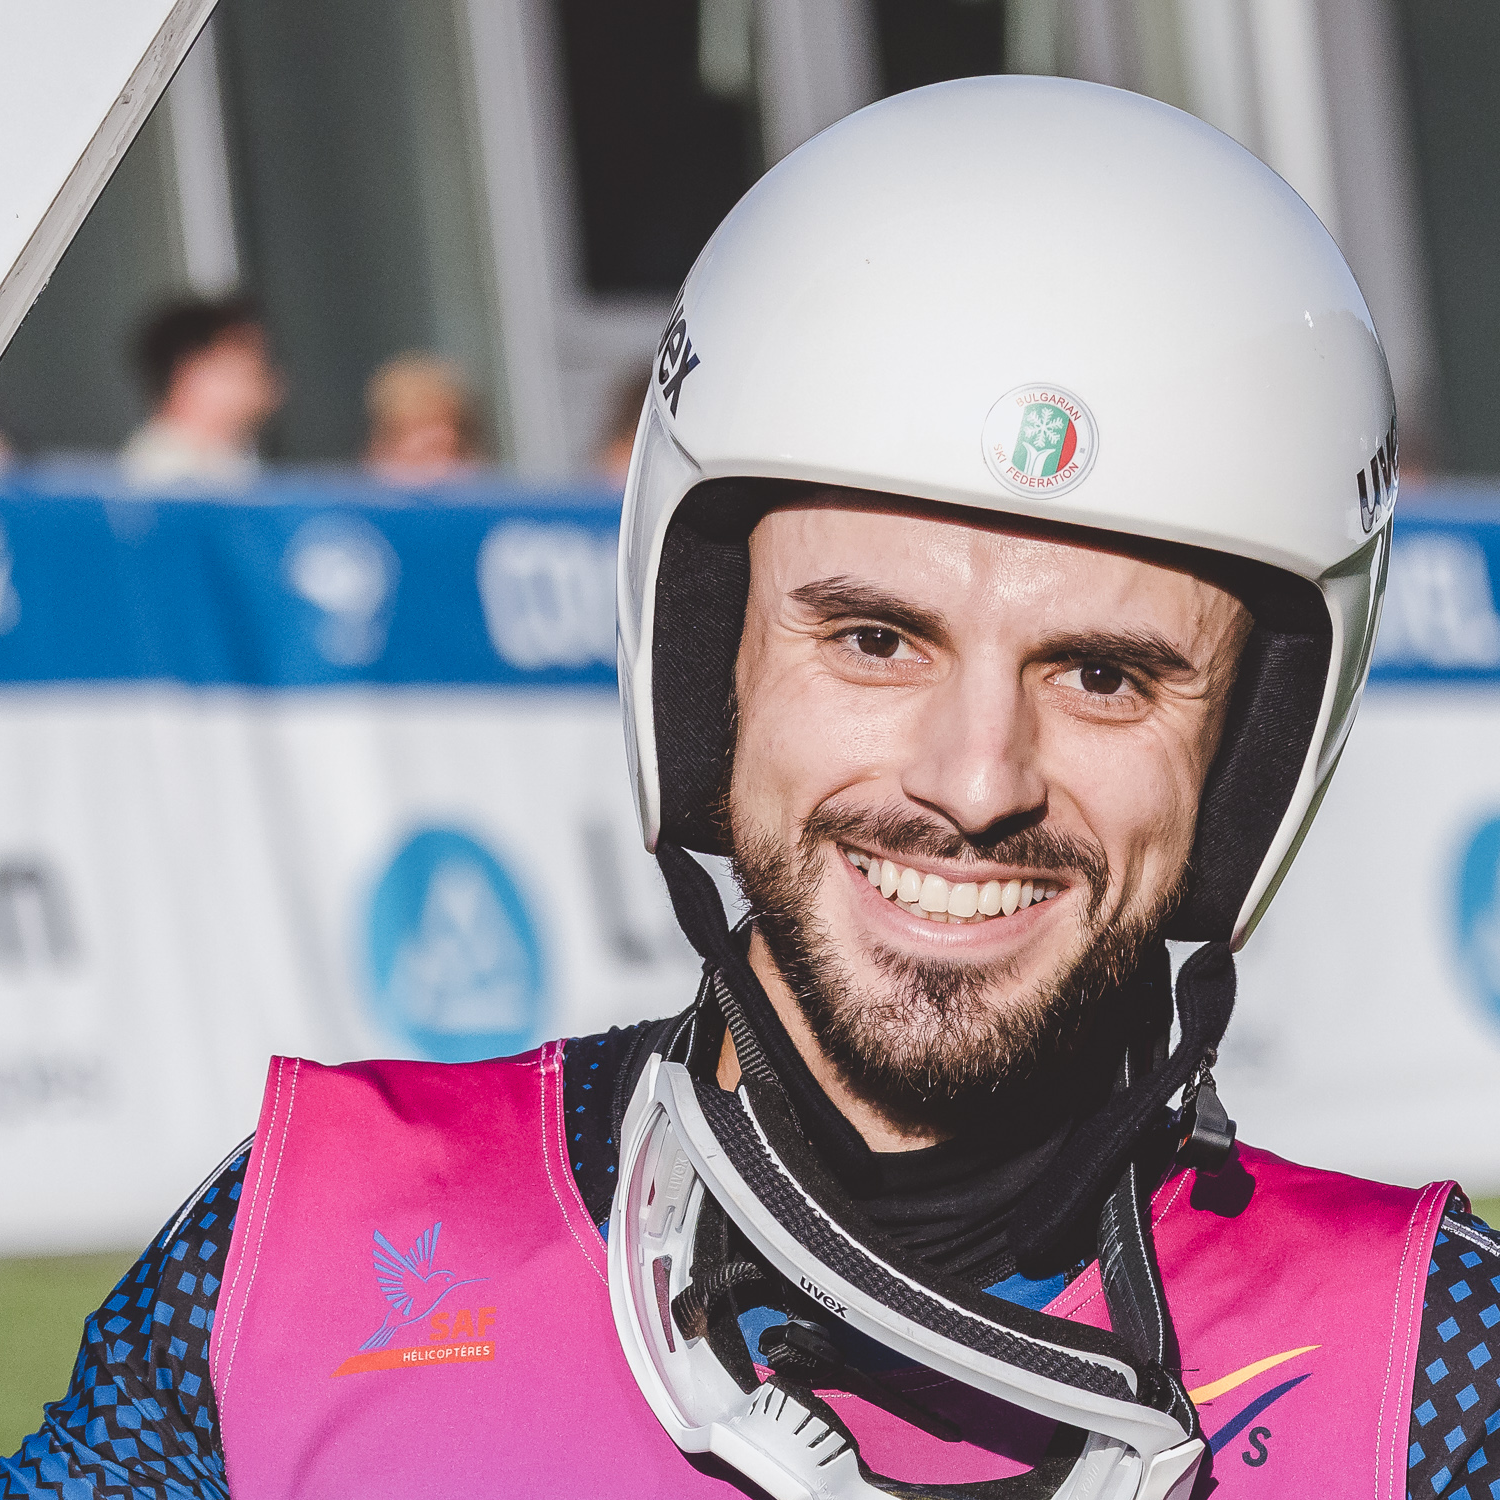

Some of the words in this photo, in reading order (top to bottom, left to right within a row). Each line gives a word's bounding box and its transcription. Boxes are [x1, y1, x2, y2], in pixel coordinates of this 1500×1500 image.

[1015, 392, 1082, 422] BULGARIAN
[993, 443, 1007, 464] SKI
[1005, 461, 1079, 488] FEDERATION
[799, 1275, 849, 1319] uvex
[428, 1306, 497, 1341] SAF
